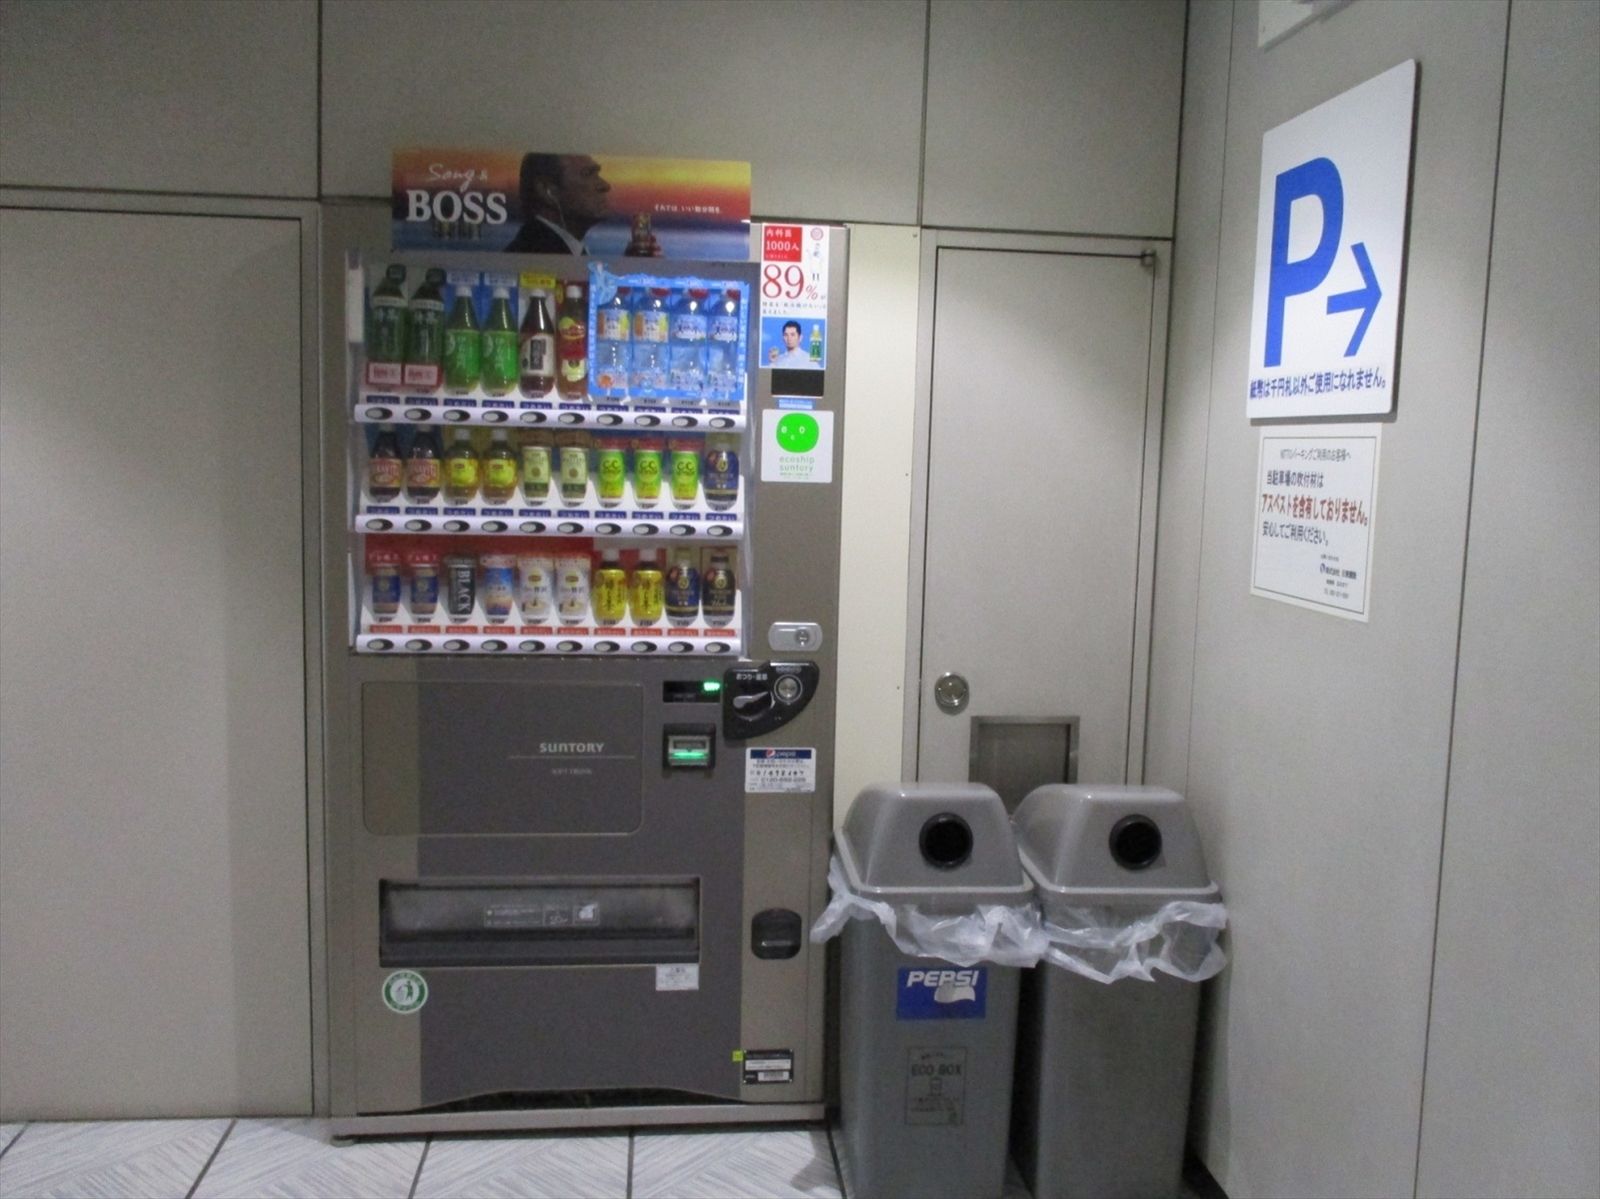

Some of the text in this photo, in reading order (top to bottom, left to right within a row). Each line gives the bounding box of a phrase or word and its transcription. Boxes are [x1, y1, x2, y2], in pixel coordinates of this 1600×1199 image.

[427, 163, 475, 193] Song
[406, 189, 508, 225] BOSS
[765, 240, 800, 252] 1000人
[1264, 157, 1344, 368] P
[1249, 367, 1386, 400] 紙幣は千円札以外ご使用になれません。
[779, 456, 815, 464] ecoship
[1262, 494, 1368, 526] アスベストを含有しておりません。
[1262, 520, 1329, 546] 安心してご利用ください。
[457, 570, 471, 611] BLACK
[906, 970, 980, 988] PEPSI
[911, 1064, 934, 1077] ECO
